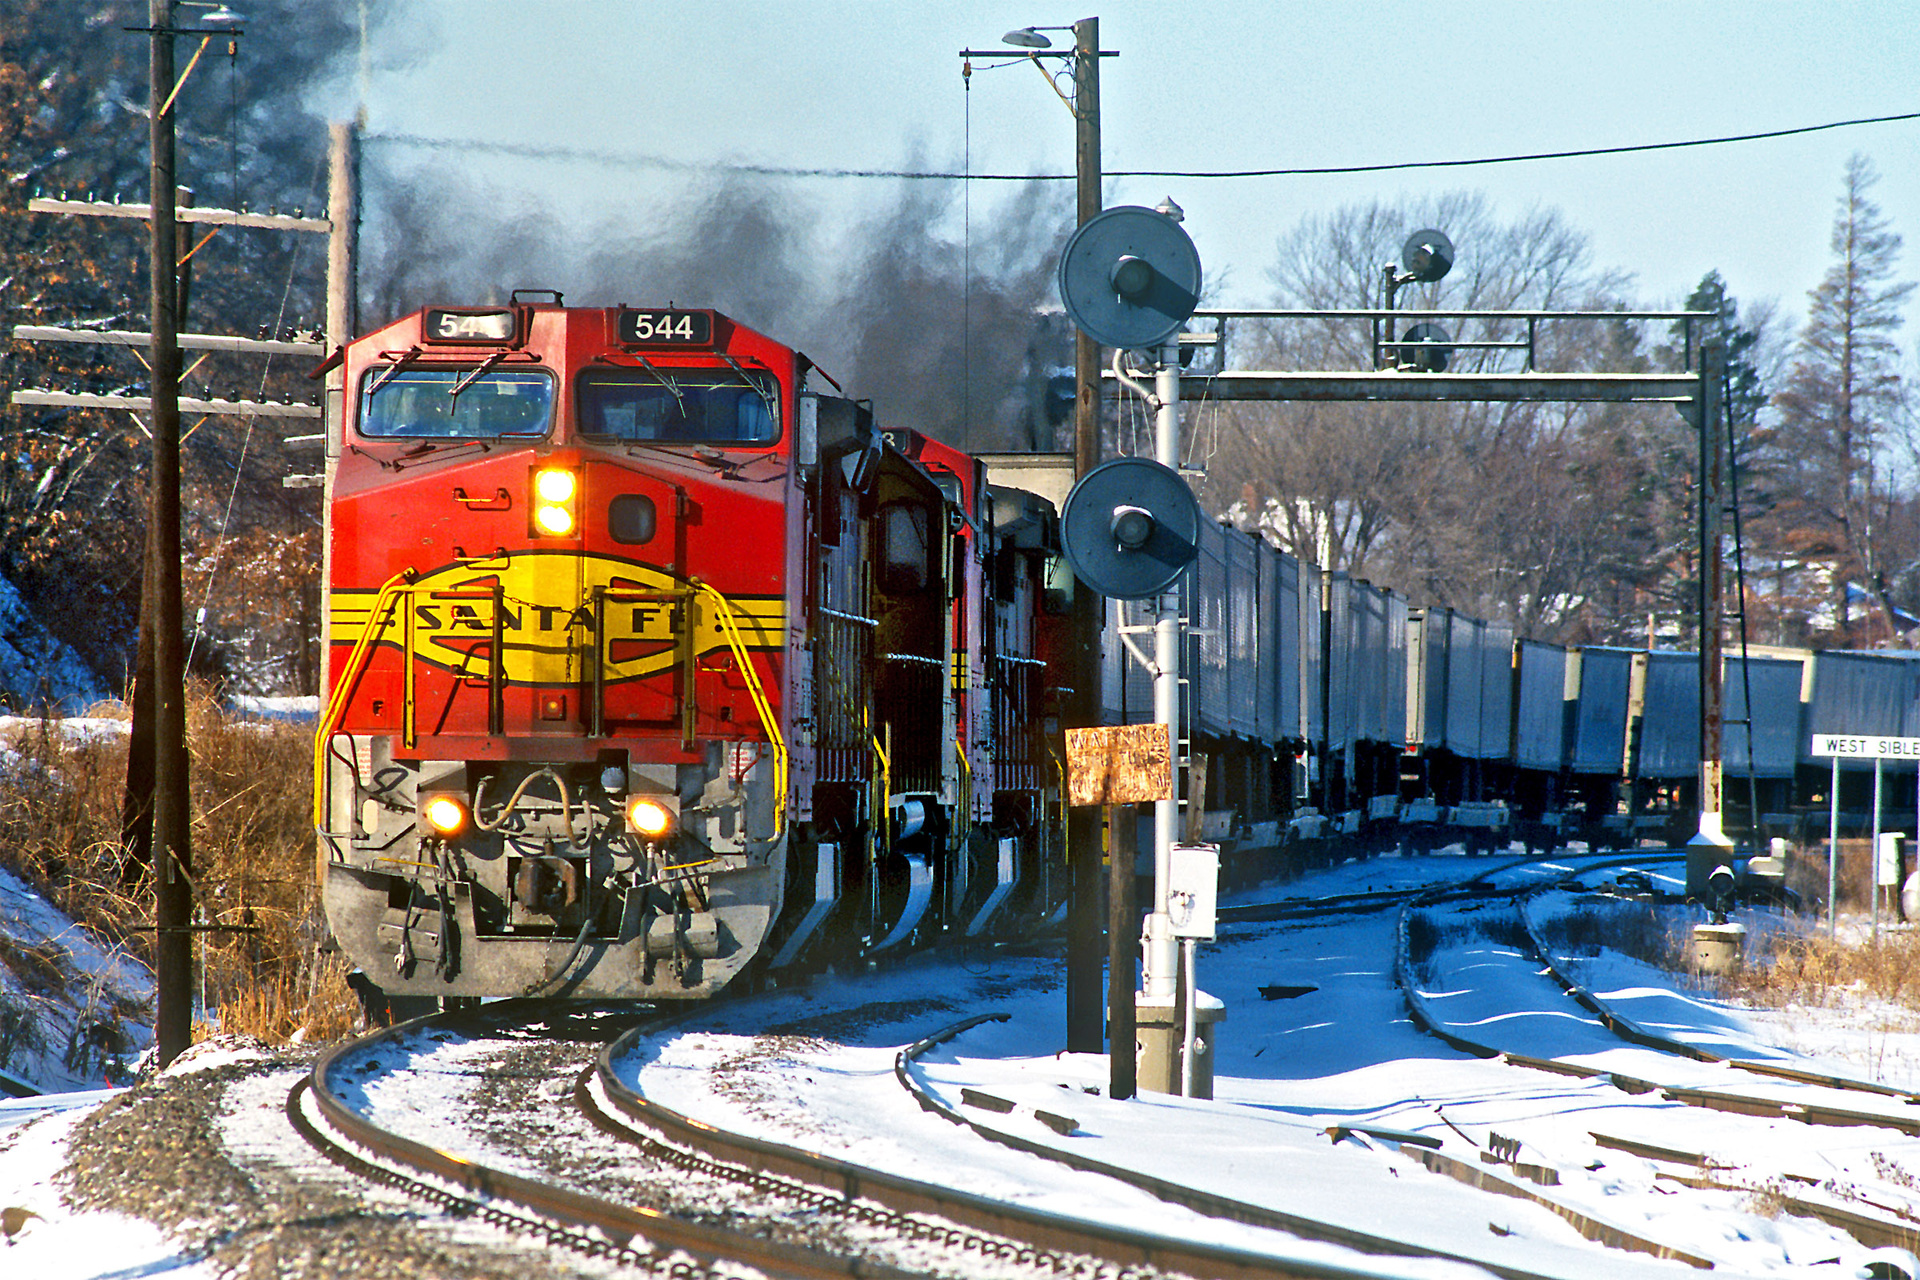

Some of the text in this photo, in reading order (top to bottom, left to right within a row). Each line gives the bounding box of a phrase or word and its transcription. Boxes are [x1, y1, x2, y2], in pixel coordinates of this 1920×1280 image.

[438, 313, 505, 339] 54
[634, 313, 694, 340] 544
[415, 604, 597, 632] SANTA
[1826, 738, 1867, 753] WEST
